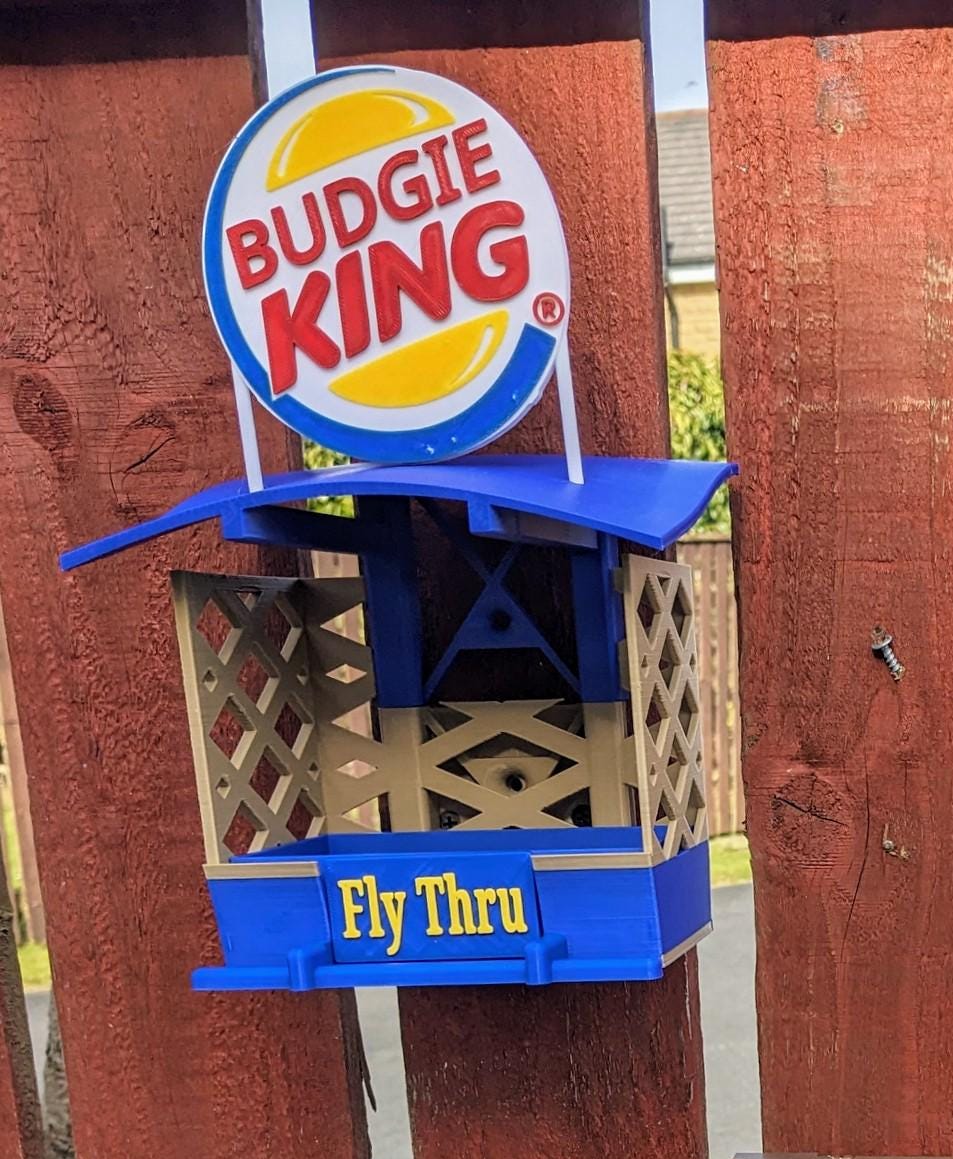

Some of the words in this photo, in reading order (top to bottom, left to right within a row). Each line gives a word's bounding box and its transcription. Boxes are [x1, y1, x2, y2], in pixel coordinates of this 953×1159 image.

[226, 118, 500, 290] BUDGIE
[261, 200, 530, 394] KING
[337, 874, 406, 956] Fly
[414, 872, 529, 937] Thru
